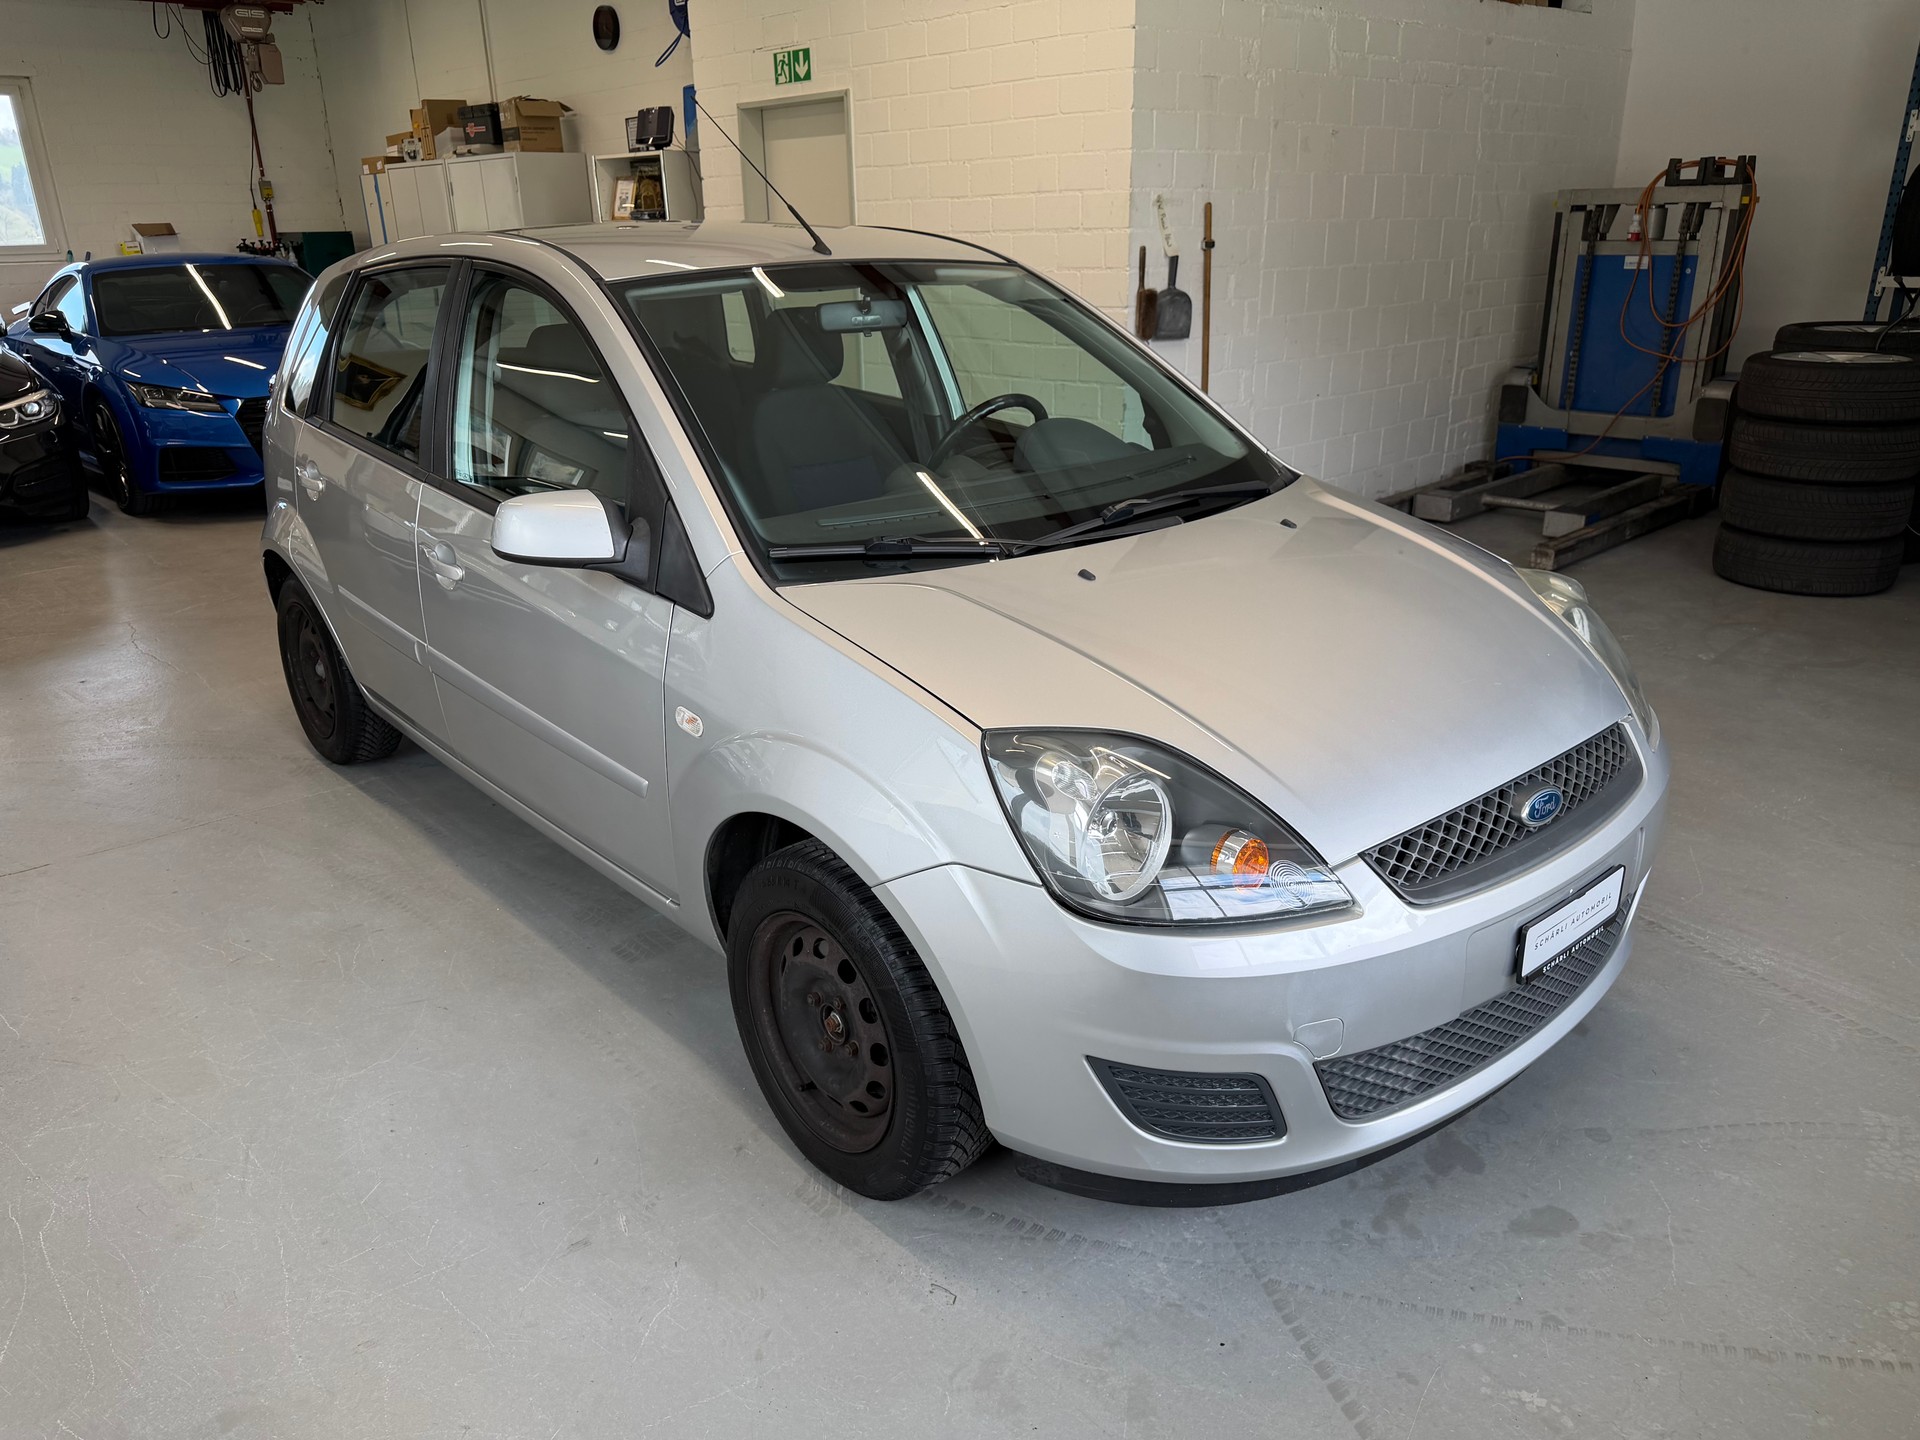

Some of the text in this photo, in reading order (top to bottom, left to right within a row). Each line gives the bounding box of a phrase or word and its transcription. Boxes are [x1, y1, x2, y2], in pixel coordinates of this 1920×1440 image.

[234, 8, 265, 18] GIS
[1534, 795, 1556, 819] Ford
[1571, 892, 1612, 928] AUTOMOBIL
[1571, 926, 1604, 954] AUTOMOBIL
